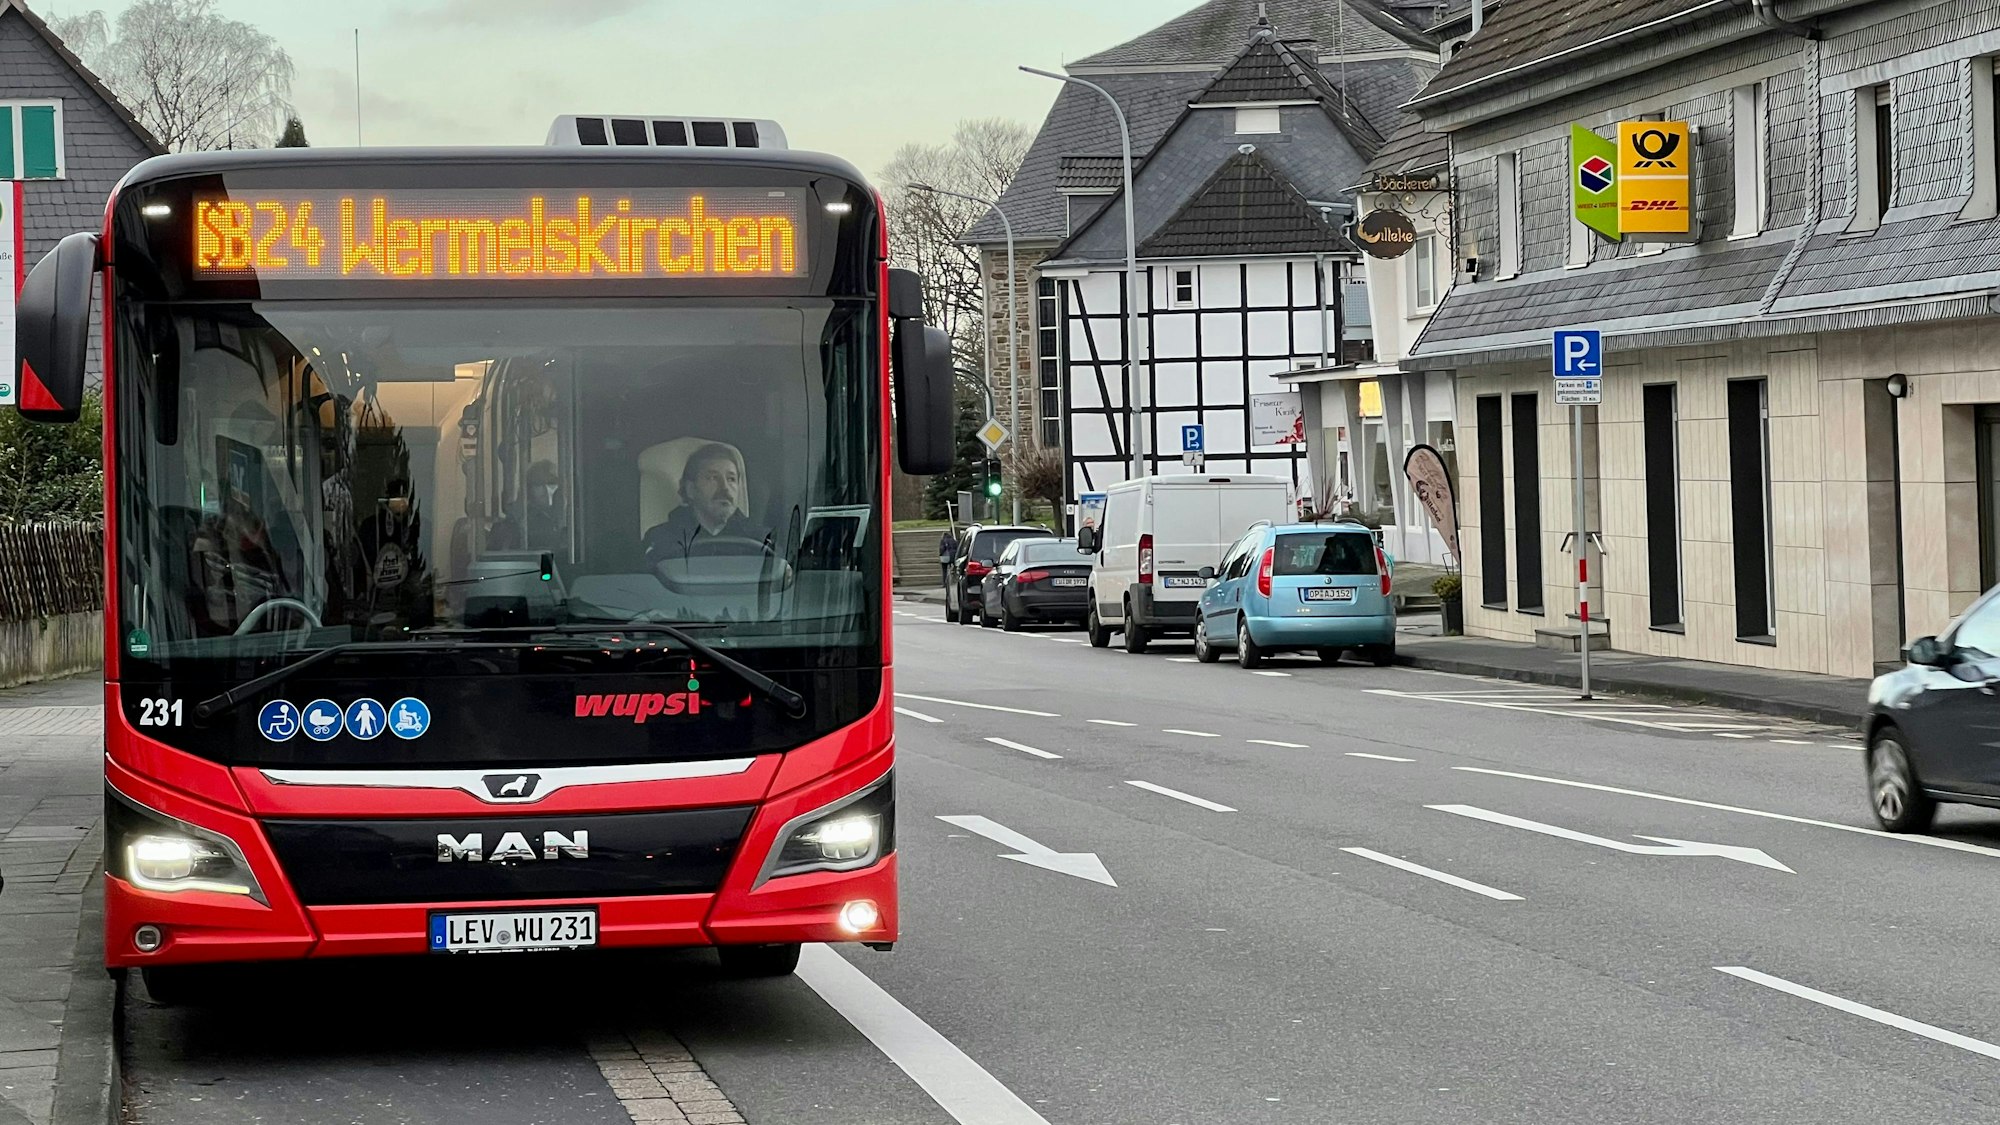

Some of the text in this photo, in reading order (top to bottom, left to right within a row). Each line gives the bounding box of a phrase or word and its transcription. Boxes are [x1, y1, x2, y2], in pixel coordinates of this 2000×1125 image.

[1630, 201, 1680, 211] DHL
[341, 196, 794, 275] Wermelskirchen
[1564, 336, 1590, 371] P
[1186, 428, 1198, 448] P
[1309, 590, 1319, 598] OP
[140, 698, 183, 726] 231
[575, 679, 699, 723] wupsi
[437, 830, 588, 862] MAN
[436, 916, 592, 944] D LEV WU 231
